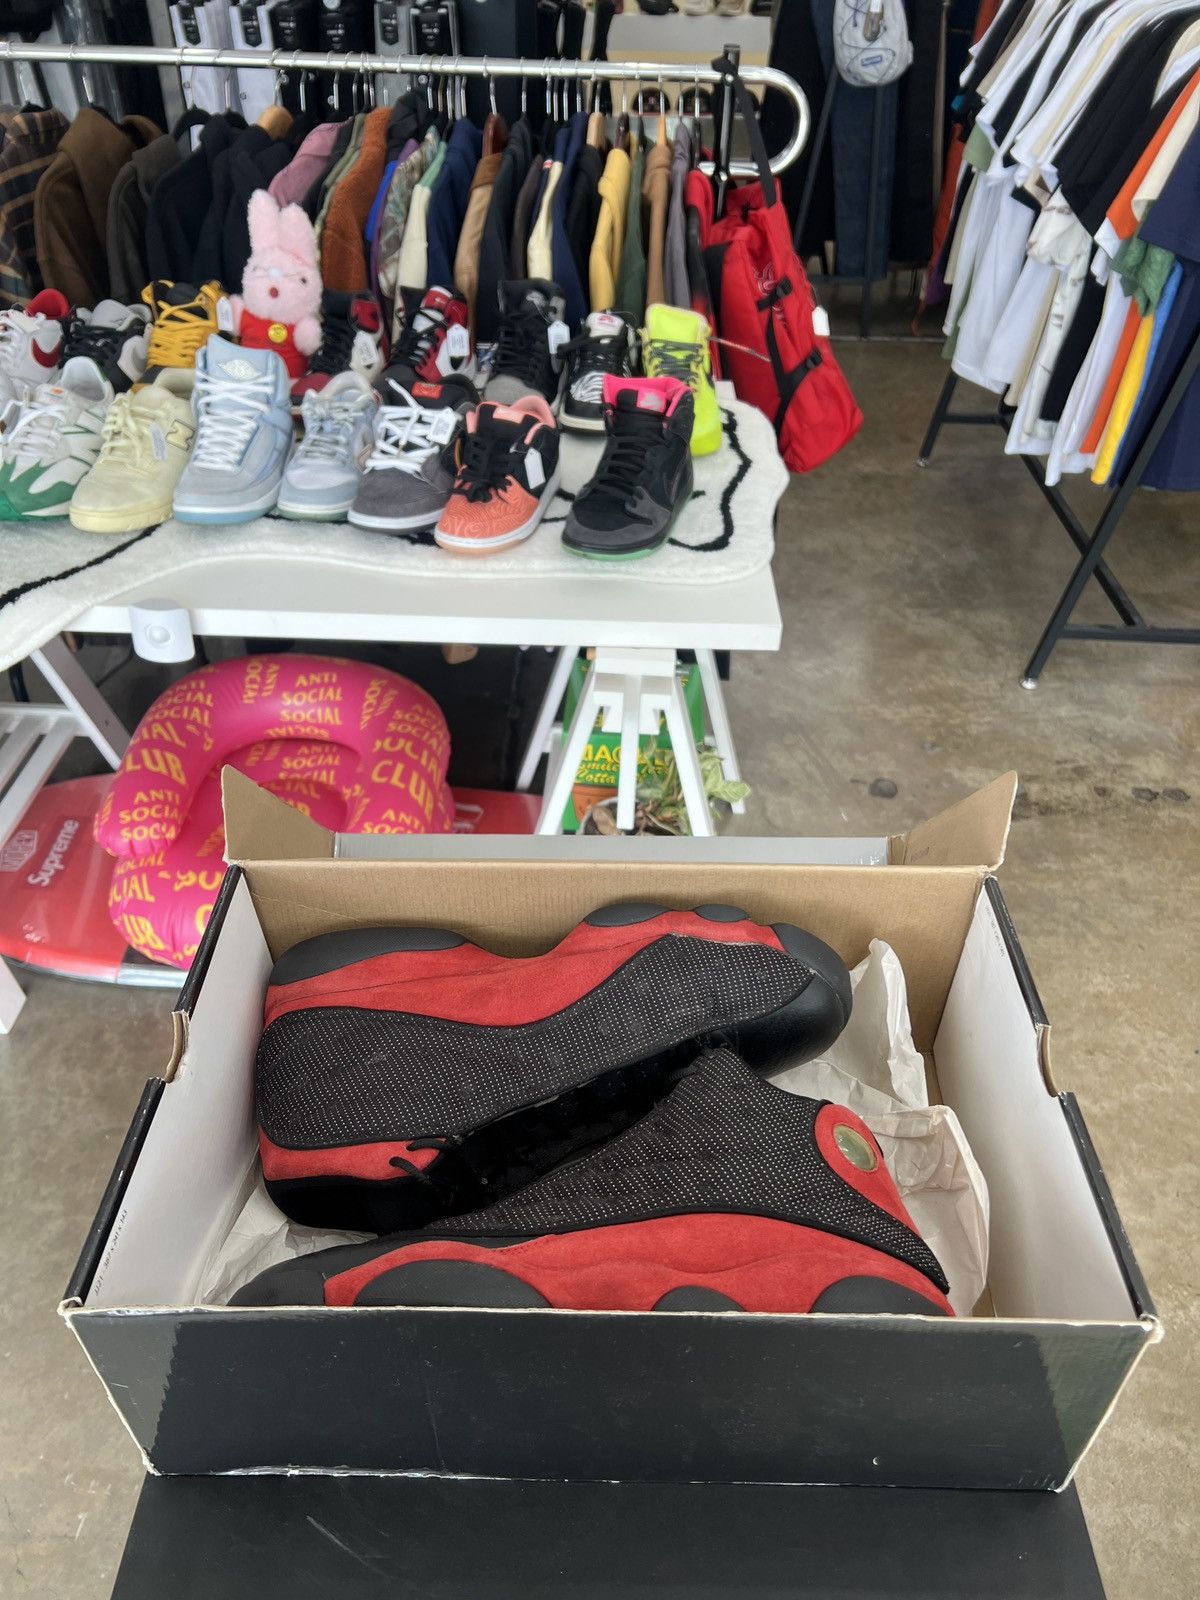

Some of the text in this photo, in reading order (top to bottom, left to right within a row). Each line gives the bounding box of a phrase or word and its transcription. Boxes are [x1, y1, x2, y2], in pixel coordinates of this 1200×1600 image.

[296, 671, 338, 688] ANTI
[281, 686, 343, 706] SOCIAL
[279, 706, 342, 726] SOCIAL
[134, 789, 180, 806] ANTI
[371, 759, 434, 824] CLUB
[27, 819, 80, 887] Supreme
